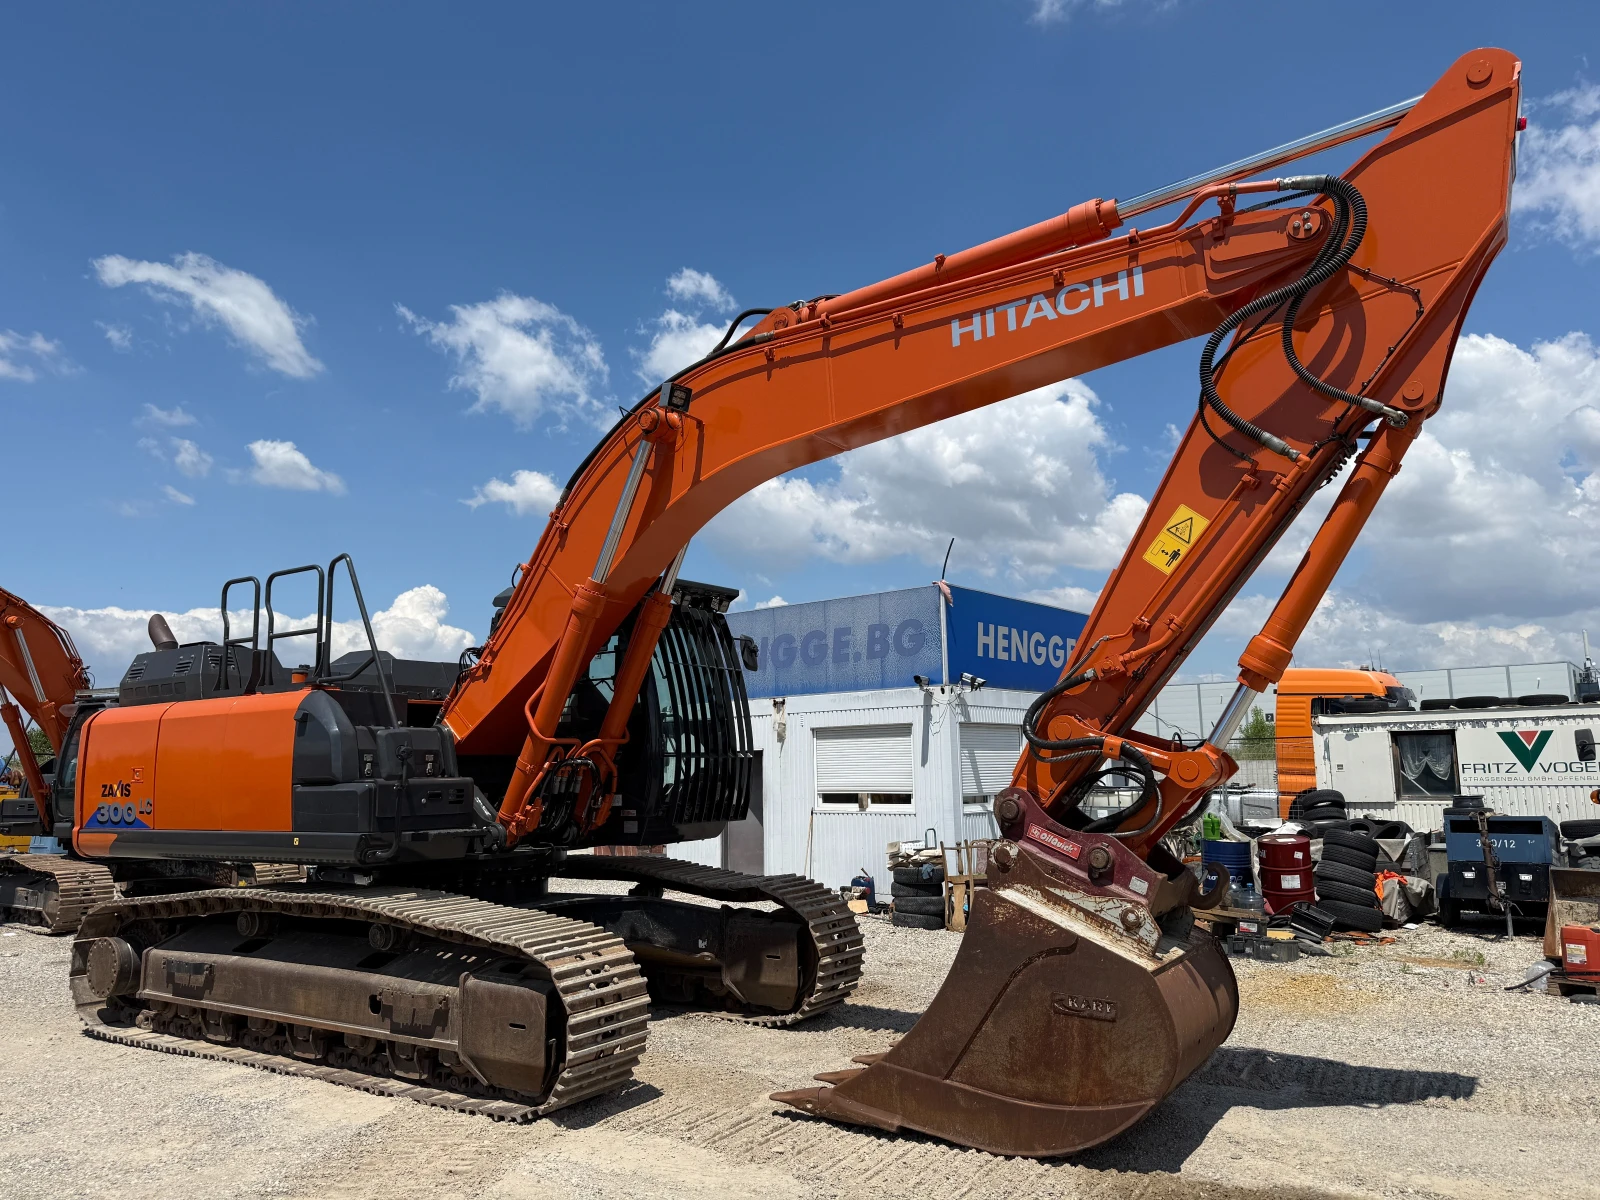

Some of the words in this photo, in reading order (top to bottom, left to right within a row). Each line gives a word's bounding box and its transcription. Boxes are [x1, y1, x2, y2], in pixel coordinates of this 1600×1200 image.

[951, 266, 1145, 348] HITACHI
[1461, 762, 1518, 774] FRITZ
[101, 779, 131, 797] ZAXIS
[96, 801, 137, 825] 300
